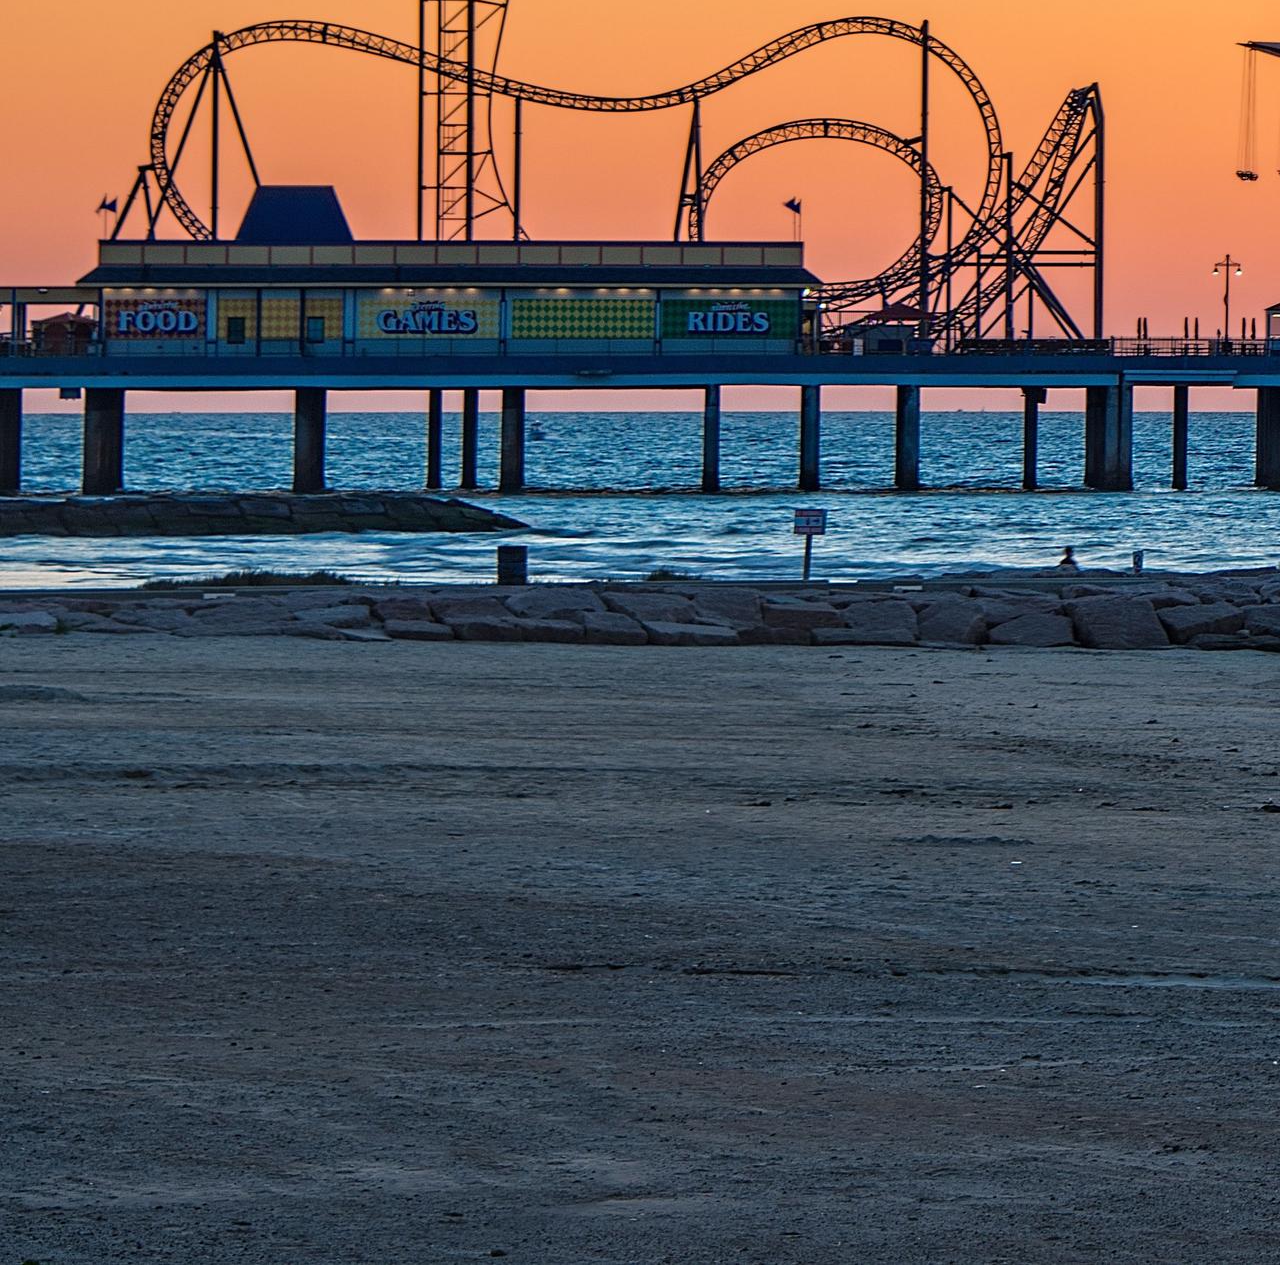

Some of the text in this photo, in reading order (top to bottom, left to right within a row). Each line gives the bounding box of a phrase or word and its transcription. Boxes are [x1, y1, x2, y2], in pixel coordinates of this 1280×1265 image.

[118, 310, 199, 332] FOOD
[377, 310, 478, 334] GAMES
[687, 311, 770, 333] RIDES
